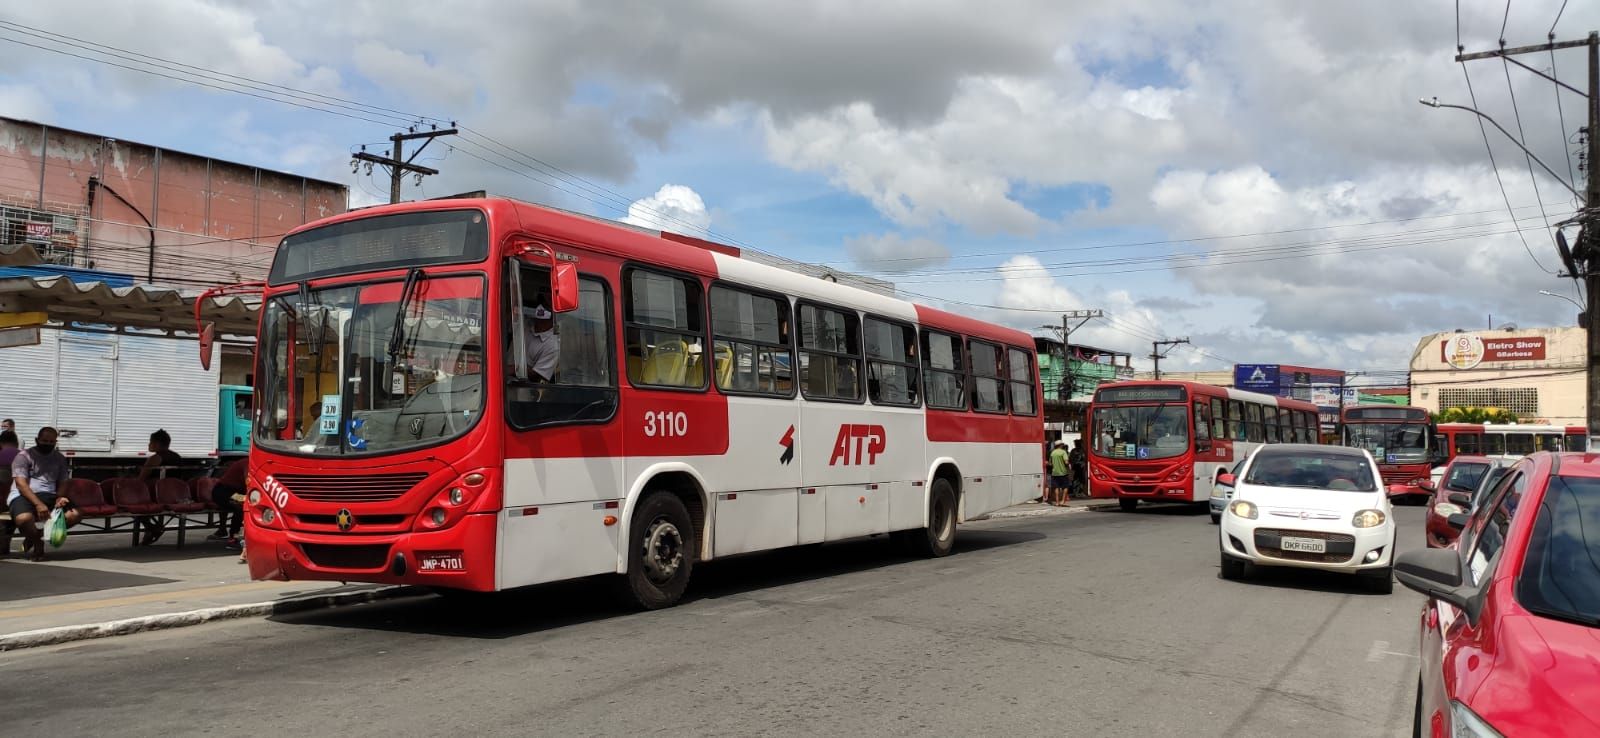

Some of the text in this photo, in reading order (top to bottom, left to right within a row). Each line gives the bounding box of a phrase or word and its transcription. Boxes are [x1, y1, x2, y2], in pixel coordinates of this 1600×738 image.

[27, 224, 51, 235] ALUGO
[1487, 341, 1542, 350] Eletro Show
[643, 410, 688, 437] 3110
[829, 423, 886, 466] ATP
[262, 475, 289, 508] 3110
[421, 557, 463, 570] JMP-4701
